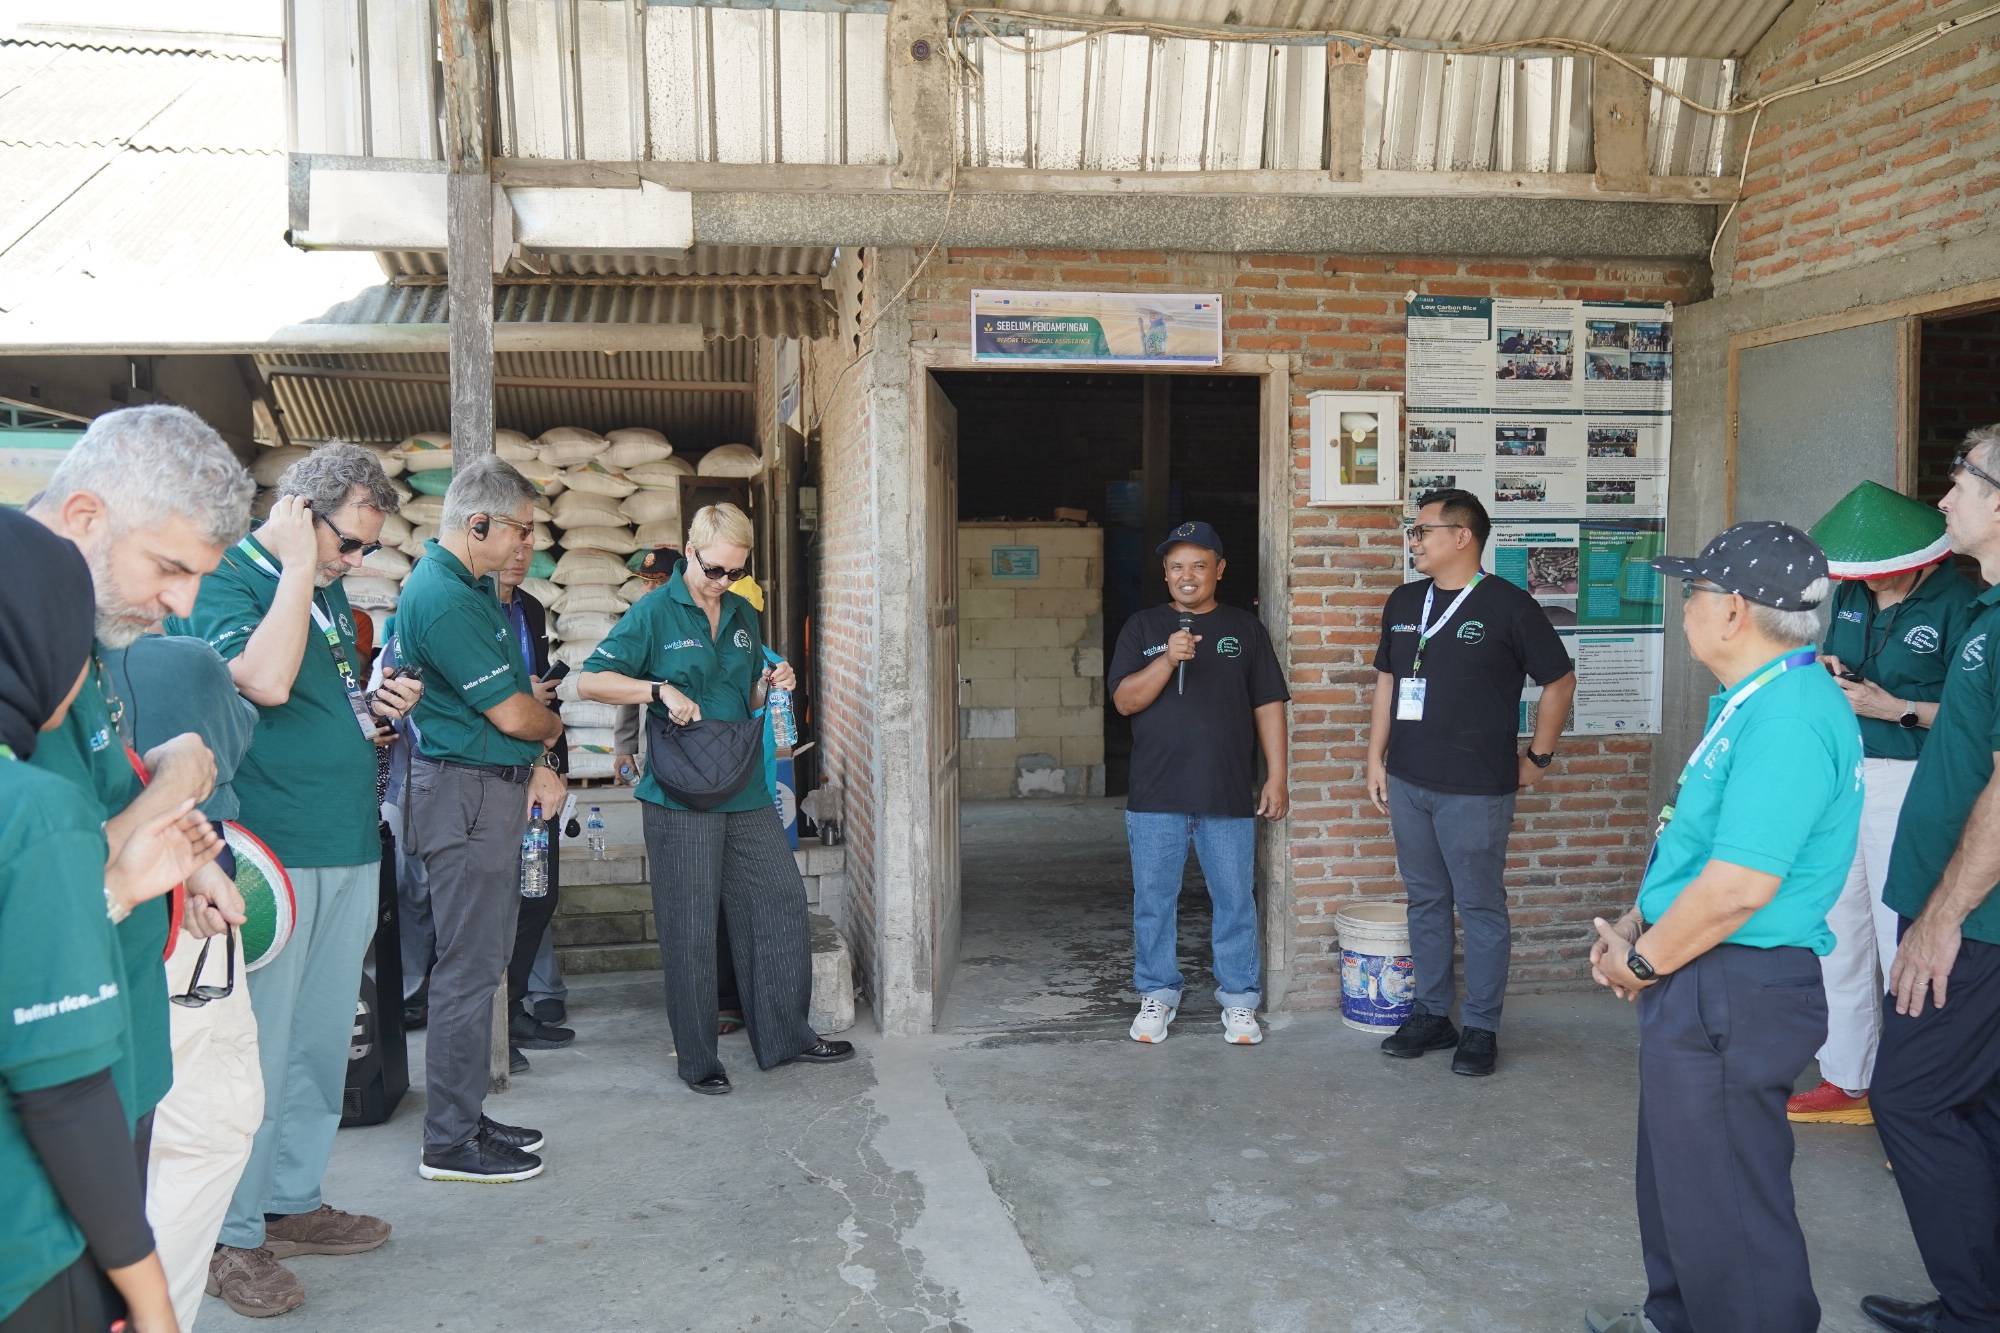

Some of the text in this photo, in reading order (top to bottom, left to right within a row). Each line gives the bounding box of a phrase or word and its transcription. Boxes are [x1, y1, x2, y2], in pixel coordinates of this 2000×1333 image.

[996, 321, 1089, 332] SEBELUM PENDAMPINGAN
[1915, 636, 1935, 649] Carbon
[13, 1002, 58, 1026] Better
